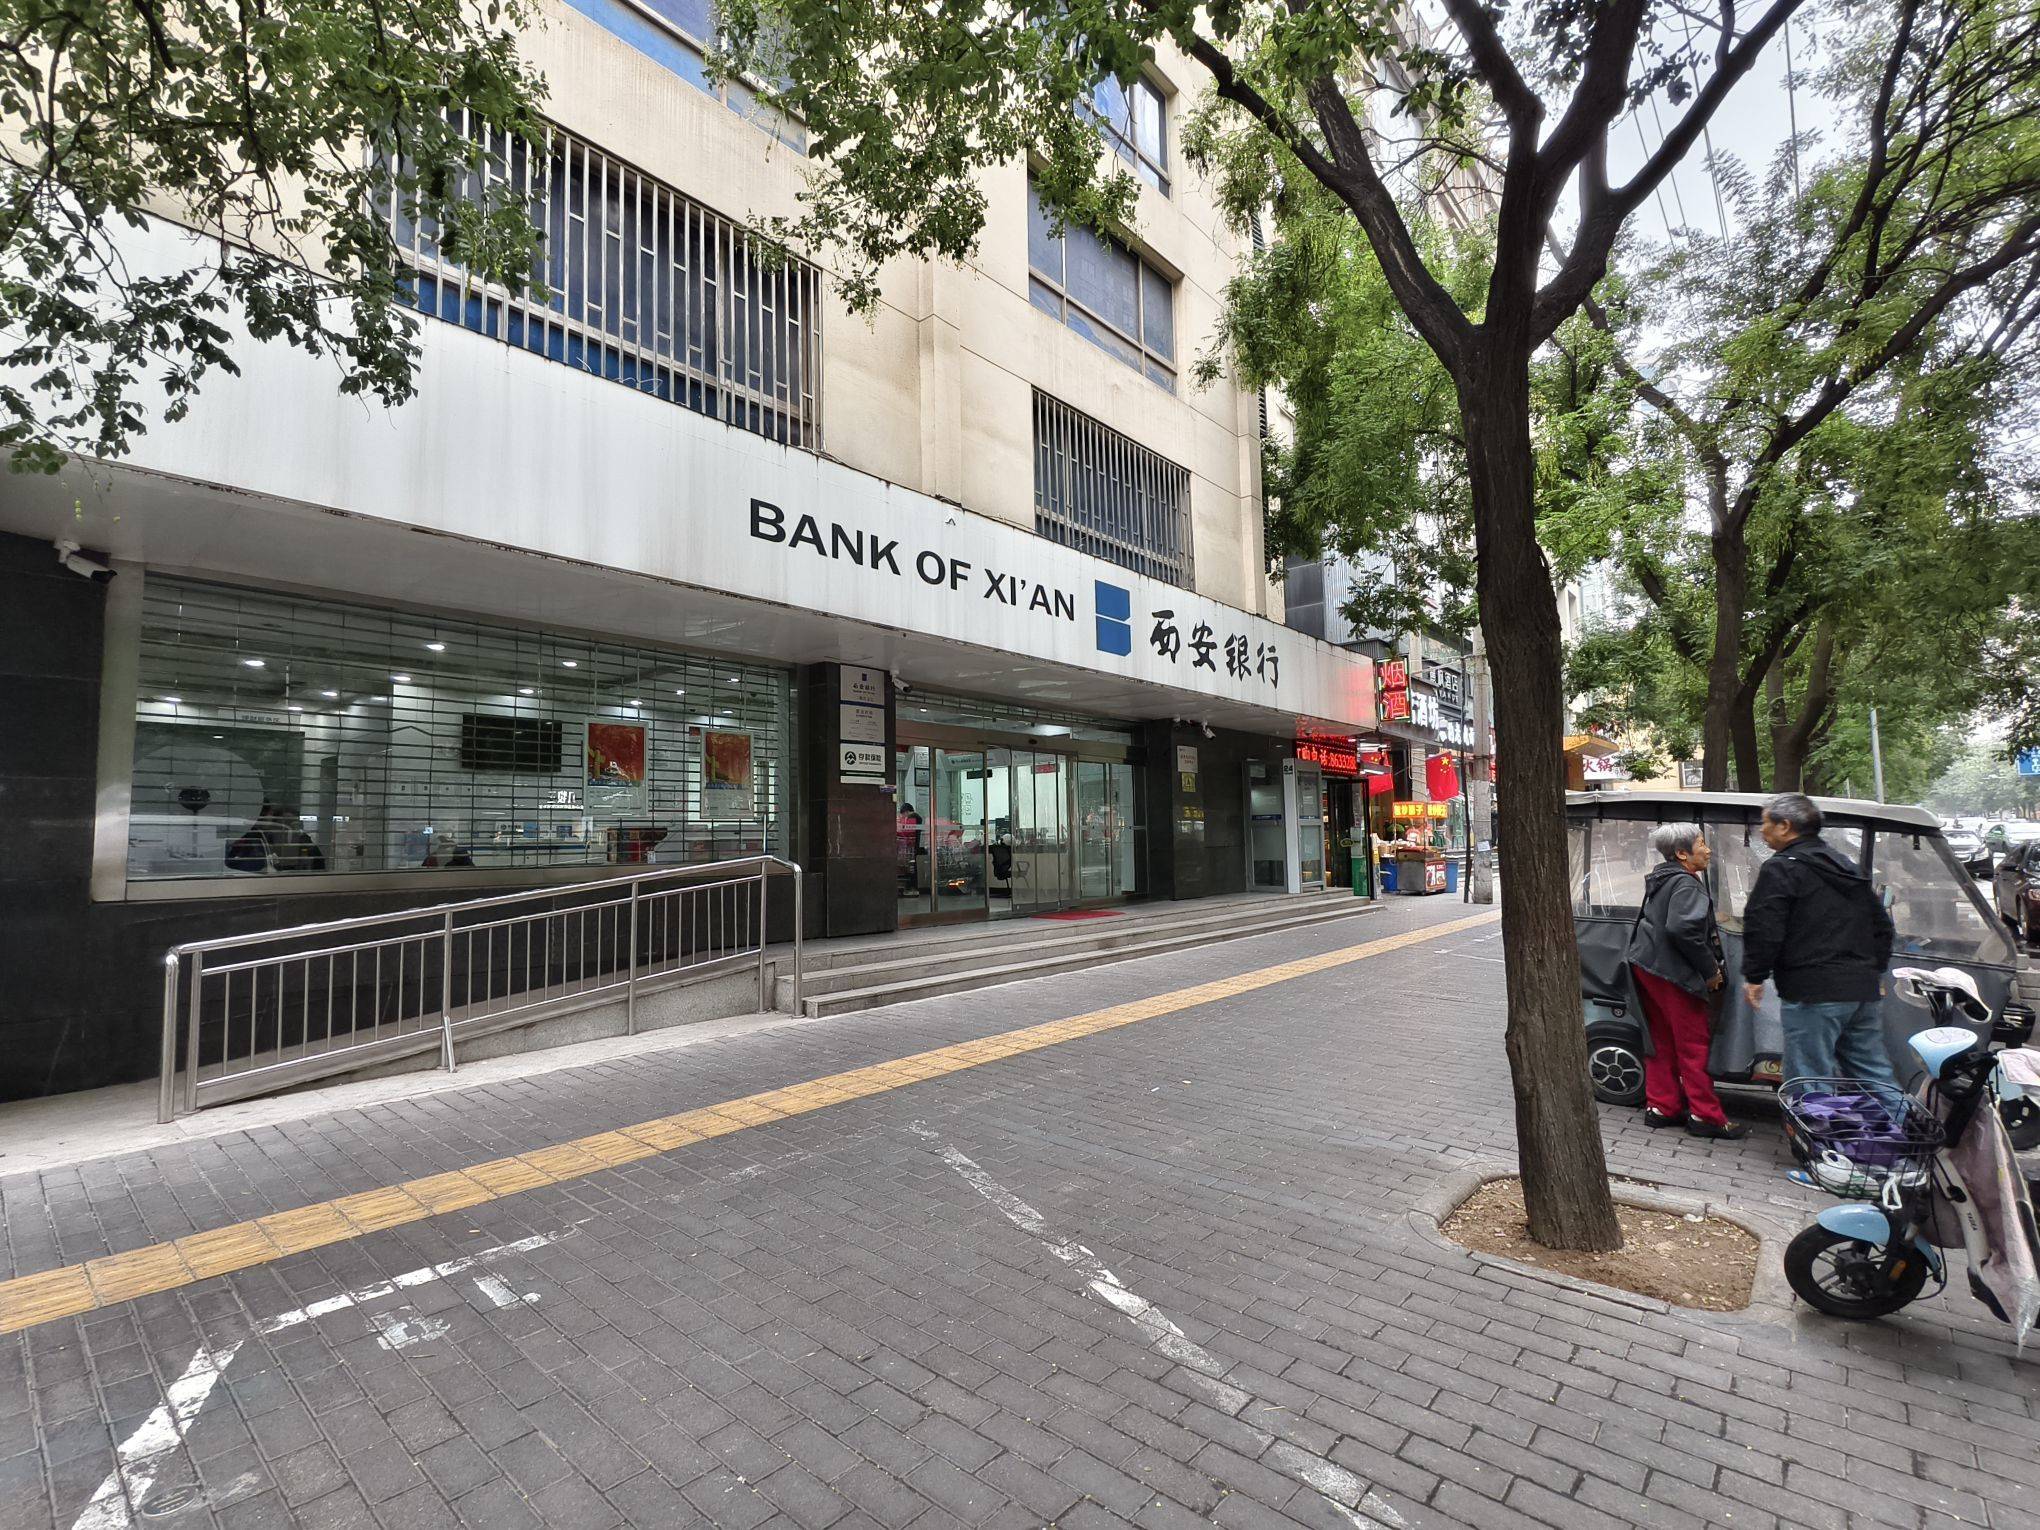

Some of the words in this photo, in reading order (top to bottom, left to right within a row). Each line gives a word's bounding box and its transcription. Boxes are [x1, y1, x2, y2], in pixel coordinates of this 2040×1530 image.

[750, 497, 901, 576] BANK
[916, 550, 972, 591] OF
[983, 568, 1075, 622] XI'AN
[1150, 609, 1279, 690] 西安银行
[1380, 660, 1408, 719] 烟酒
